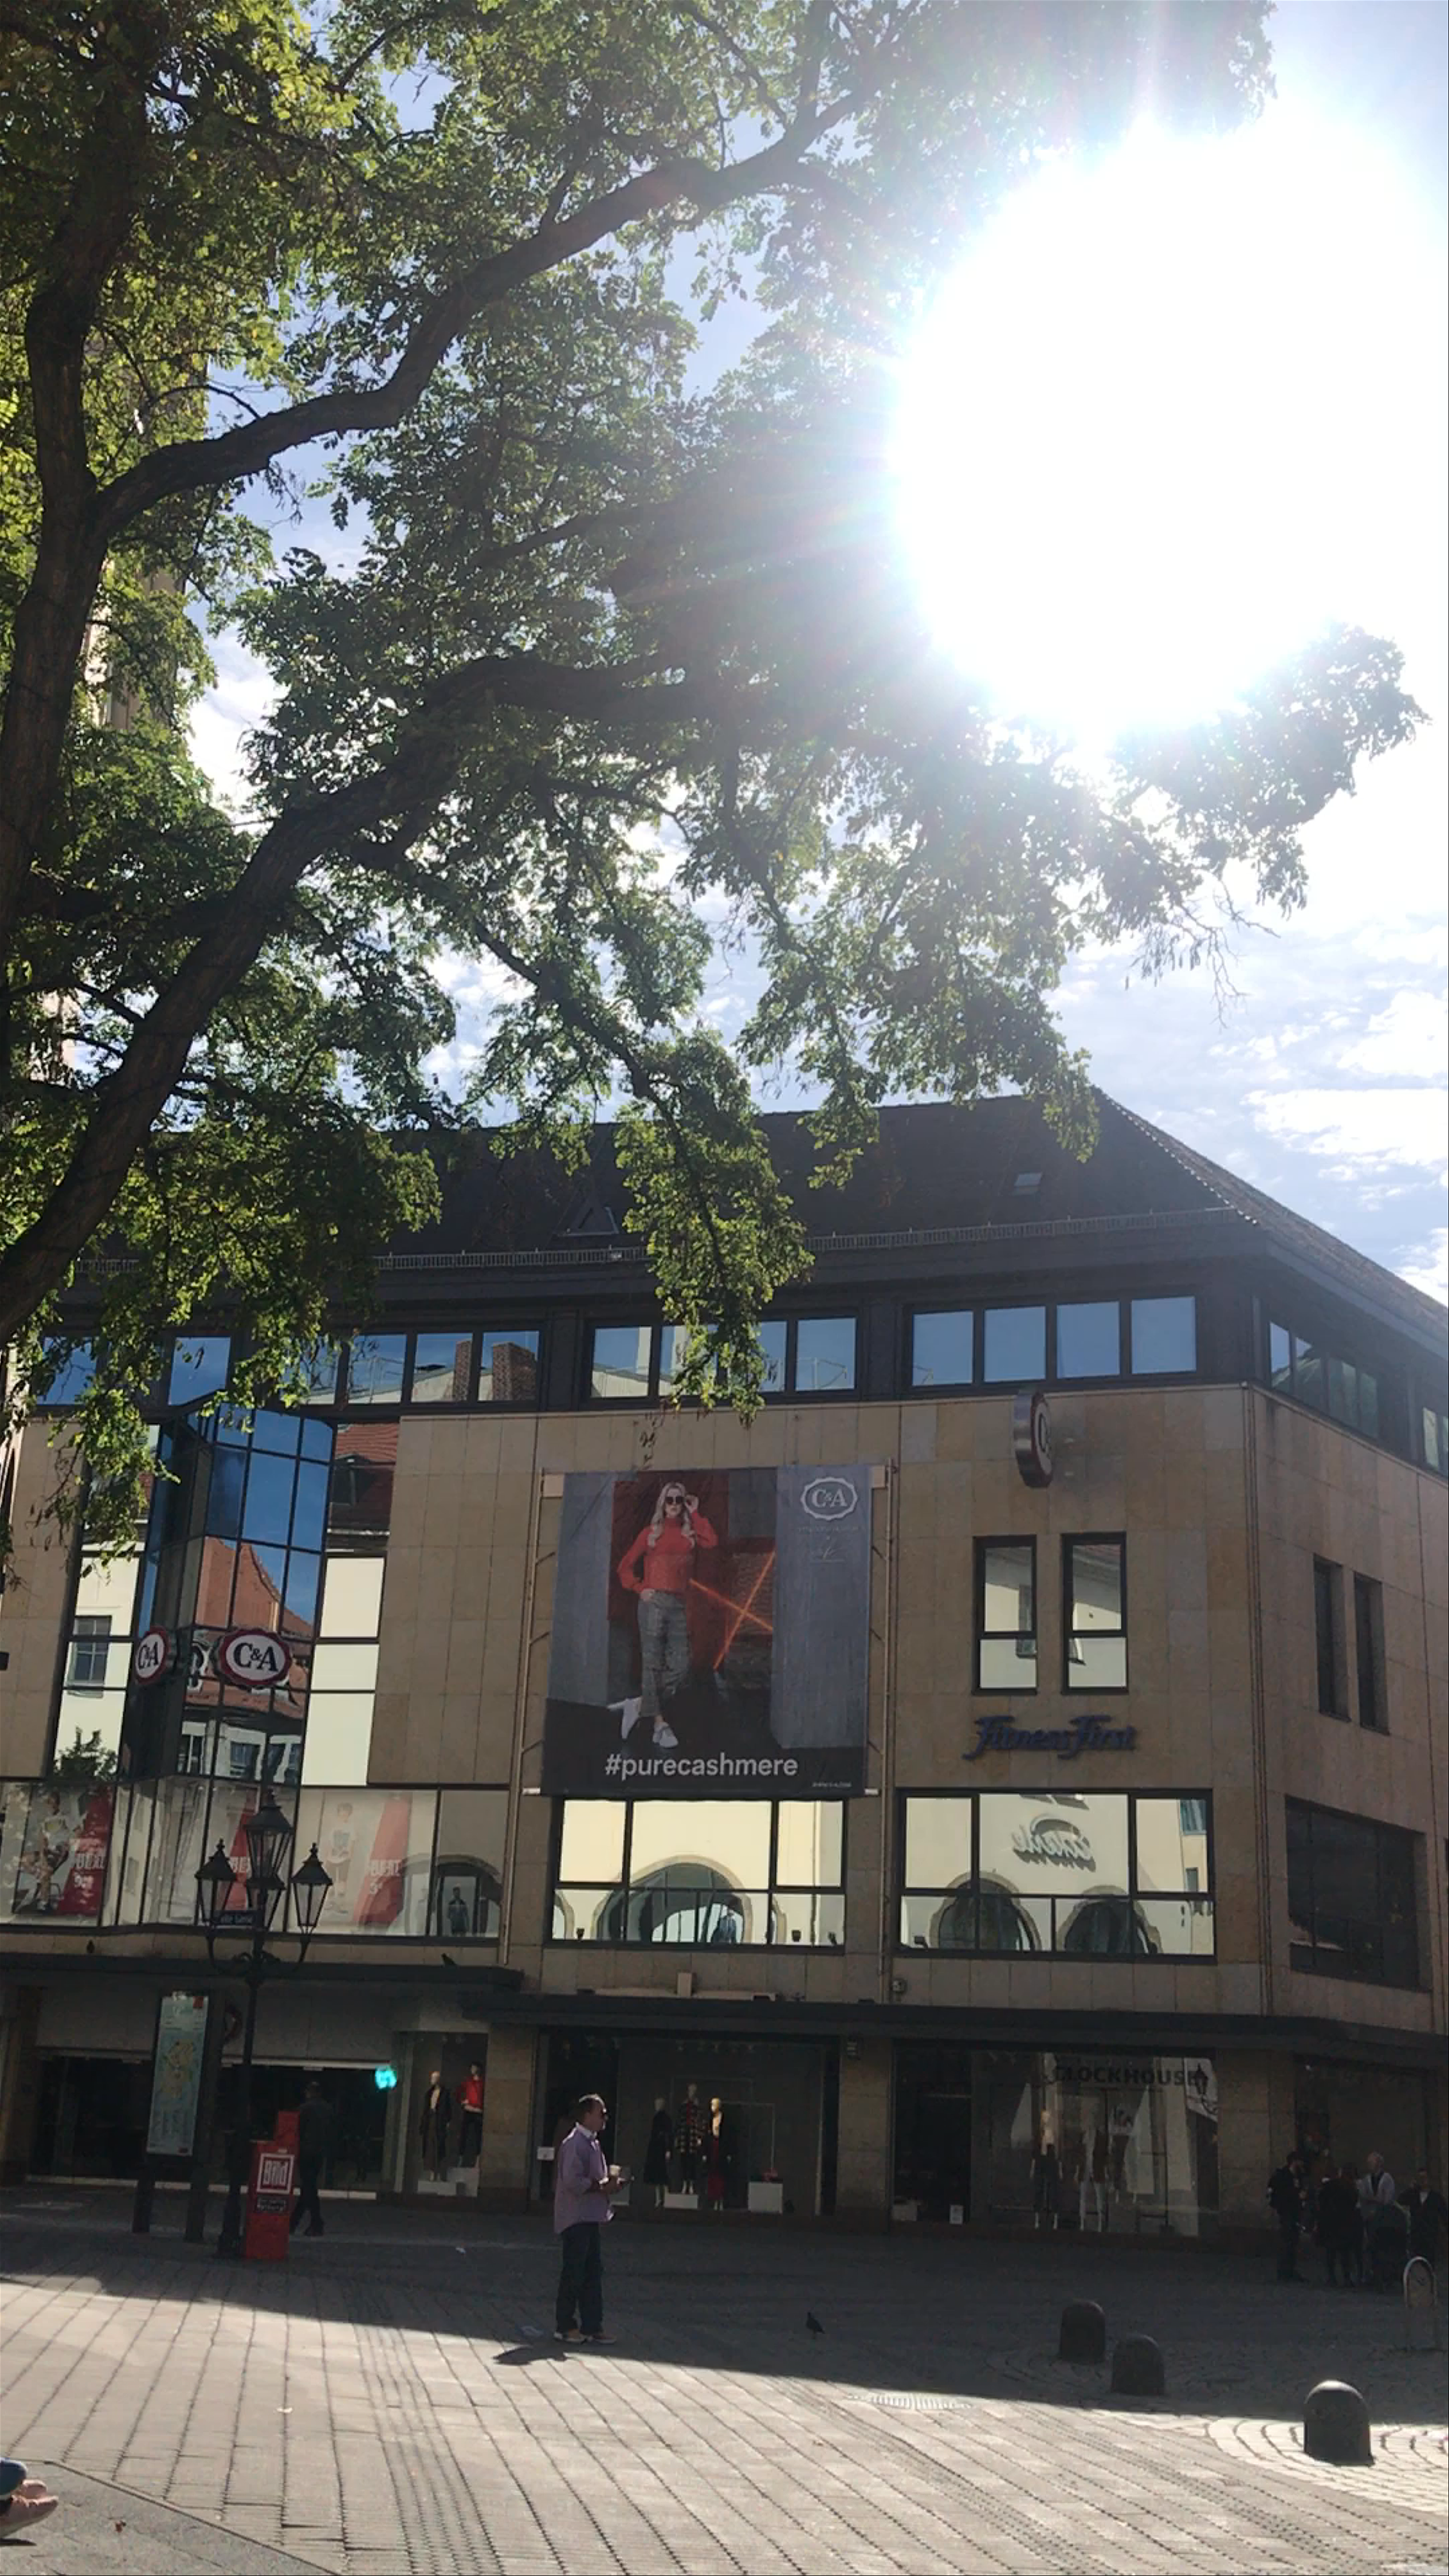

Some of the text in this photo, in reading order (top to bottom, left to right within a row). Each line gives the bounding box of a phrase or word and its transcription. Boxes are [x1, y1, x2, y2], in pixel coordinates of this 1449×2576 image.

[812, 1489, 848, 1508] C&A
[138, 1642, 158, 1669] C&A
[234, 1643, 278, 1672] C&A
[605, 1753, 798, 1781] #purecashmere
